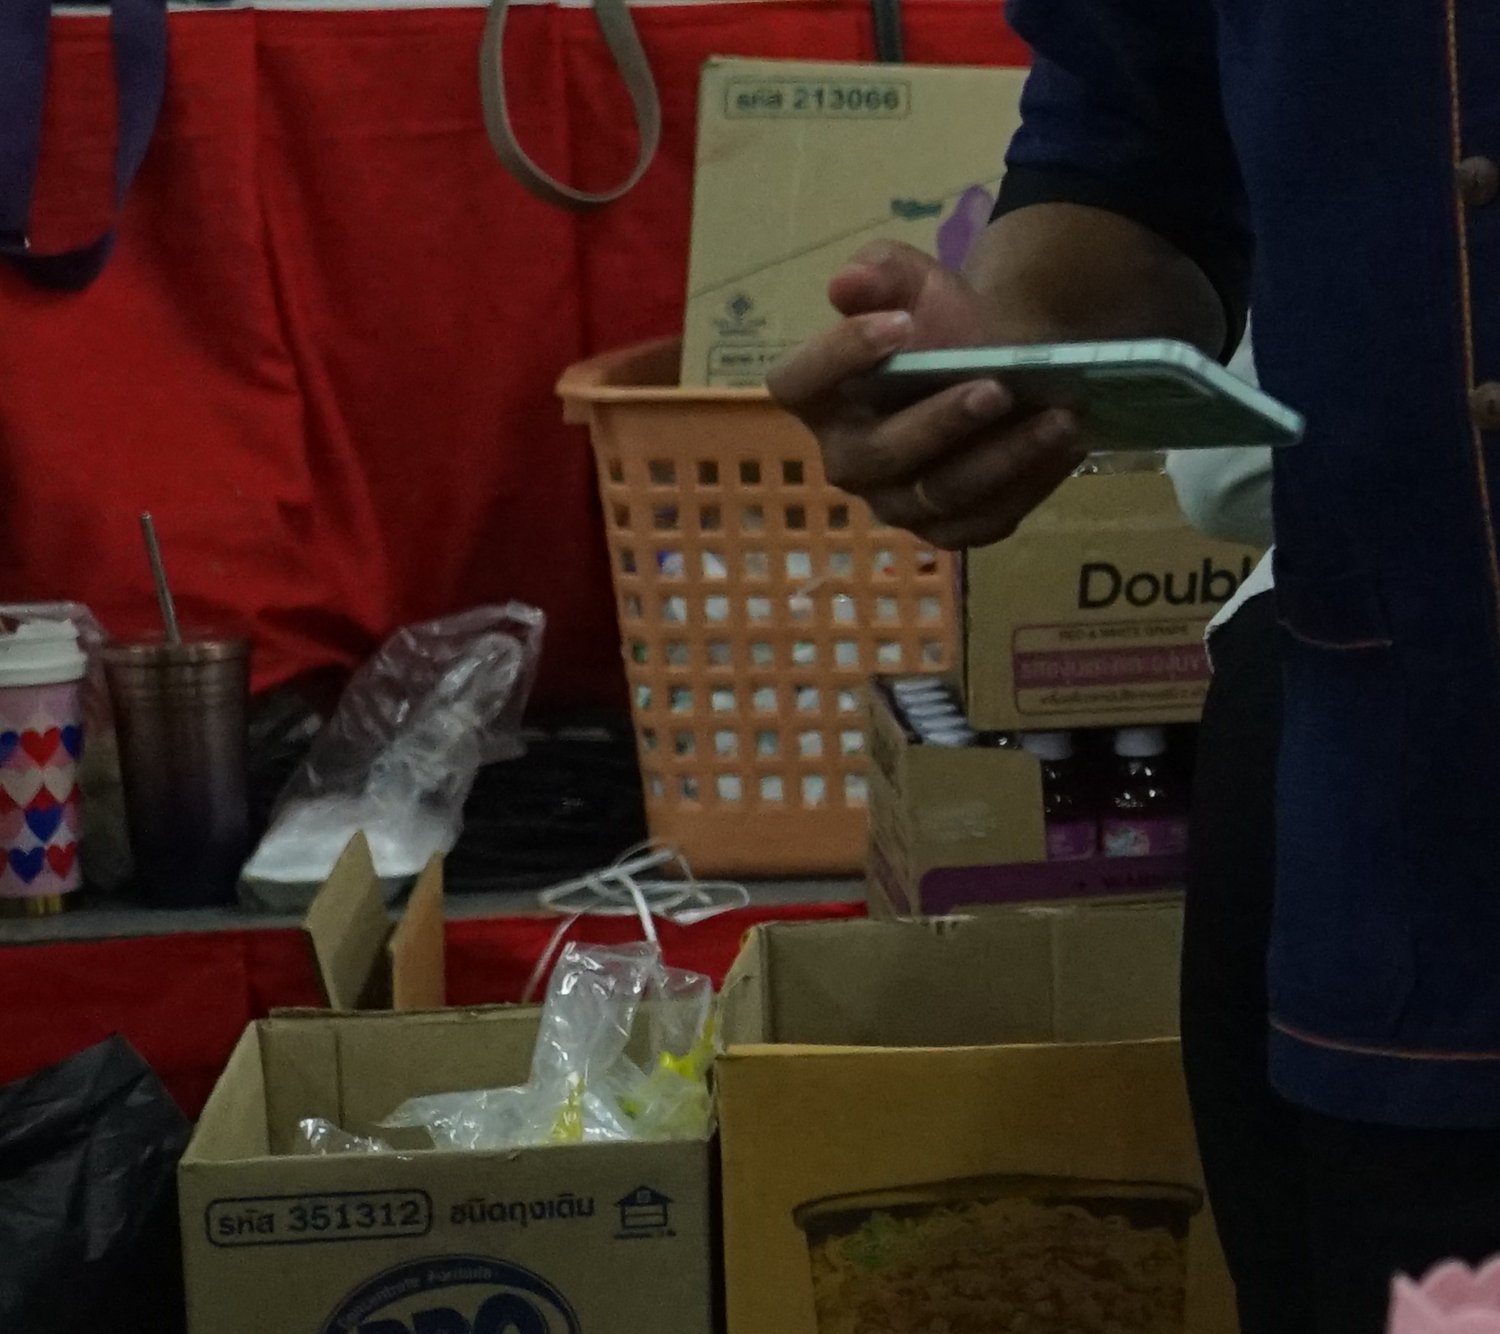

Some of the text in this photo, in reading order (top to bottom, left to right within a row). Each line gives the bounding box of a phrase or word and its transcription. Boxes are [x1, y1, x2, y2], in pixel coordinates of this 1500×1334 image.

[793, 86, 899, 110] 213066
[217, 1199, 422, 1237] รหัส 351312
[449, 1192, 595, 1230] ชนิดถุงเติม
